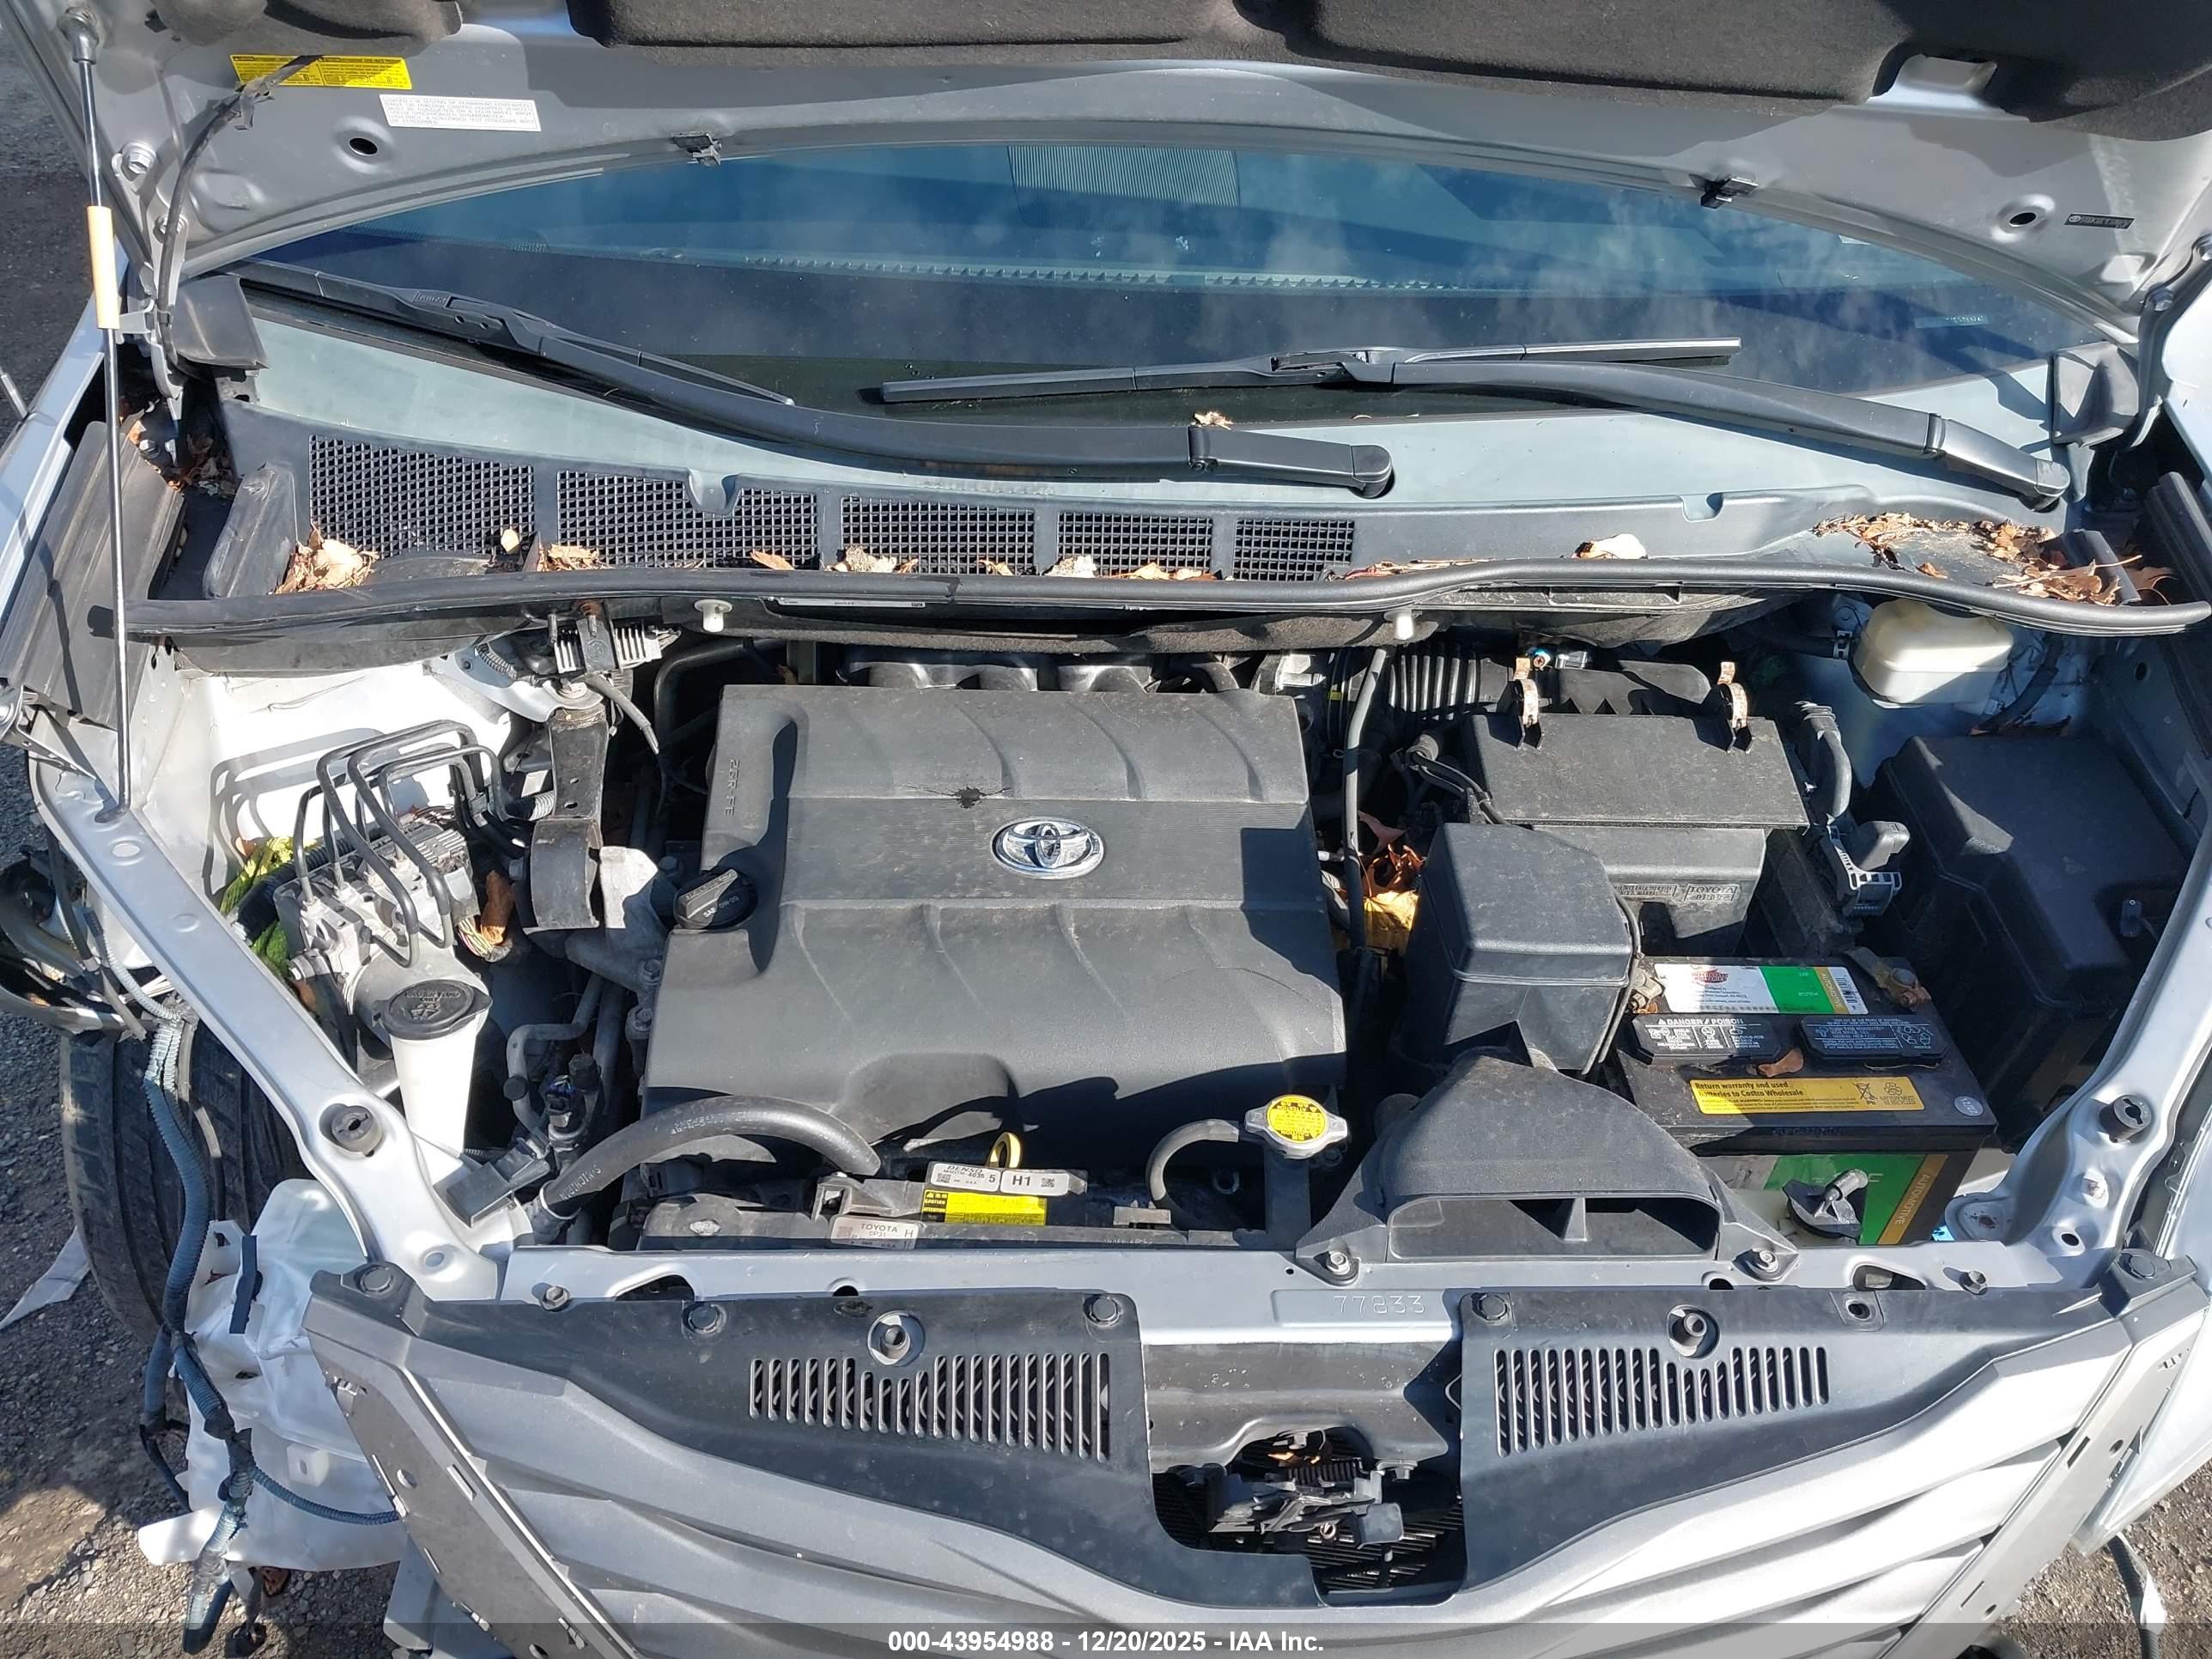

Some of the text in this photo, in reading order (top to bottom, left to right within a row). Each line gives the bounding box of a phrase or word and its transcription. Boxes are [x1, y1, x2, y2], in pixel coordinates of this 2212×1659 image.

[702, 906, 717, 918] SAE
[1695, 1081, 1719, 1090] Return
[1721, 1082, 1753, 1091] warranty
[1741, 1089, 1765, 1097] Costco
[1765, 1088, 1804, 1097] Wholesale
[946, 1164, 983, 1175] DENSO
[988, 1174, 996, 1183] 5
[1012, 1175, 1030, 1187] H1
[1895, 1174, 1930, 1225] AUTOMOTIVE
[860, 1223, 898, 1233] TOYOTA
[904, 1229, 914, 1238] H
[1333, 1295, 1426, 1315] 77833
